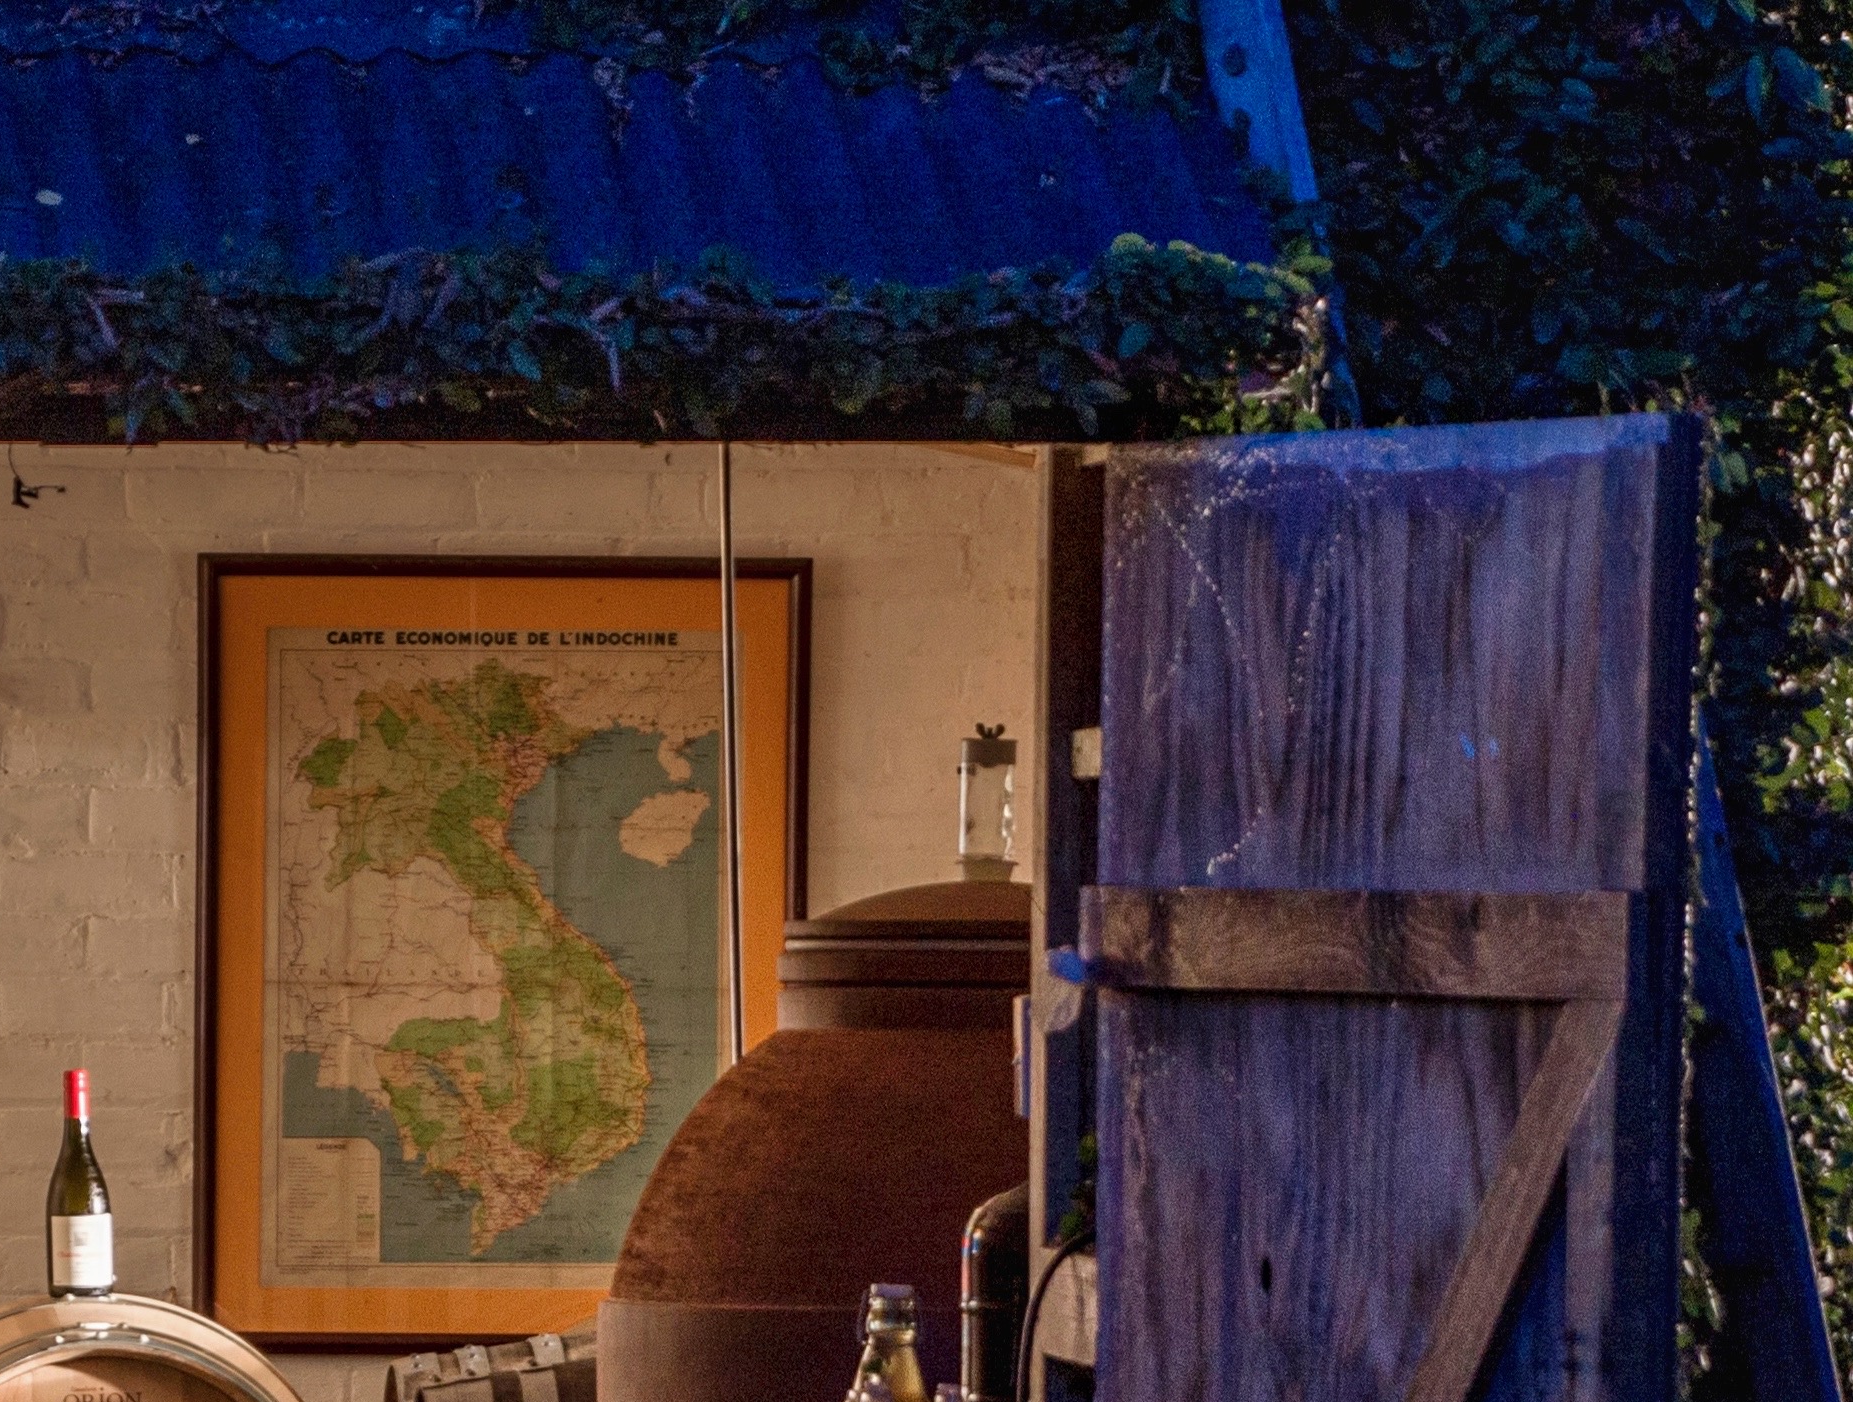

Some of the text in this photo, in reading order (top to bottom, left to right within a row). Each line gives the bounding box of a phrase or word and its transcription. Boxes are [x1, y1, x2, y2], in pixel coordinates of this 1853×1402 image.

[326, 631, 678, 647] CARTE ECONOMIQUE DE L'INDOCHINE
